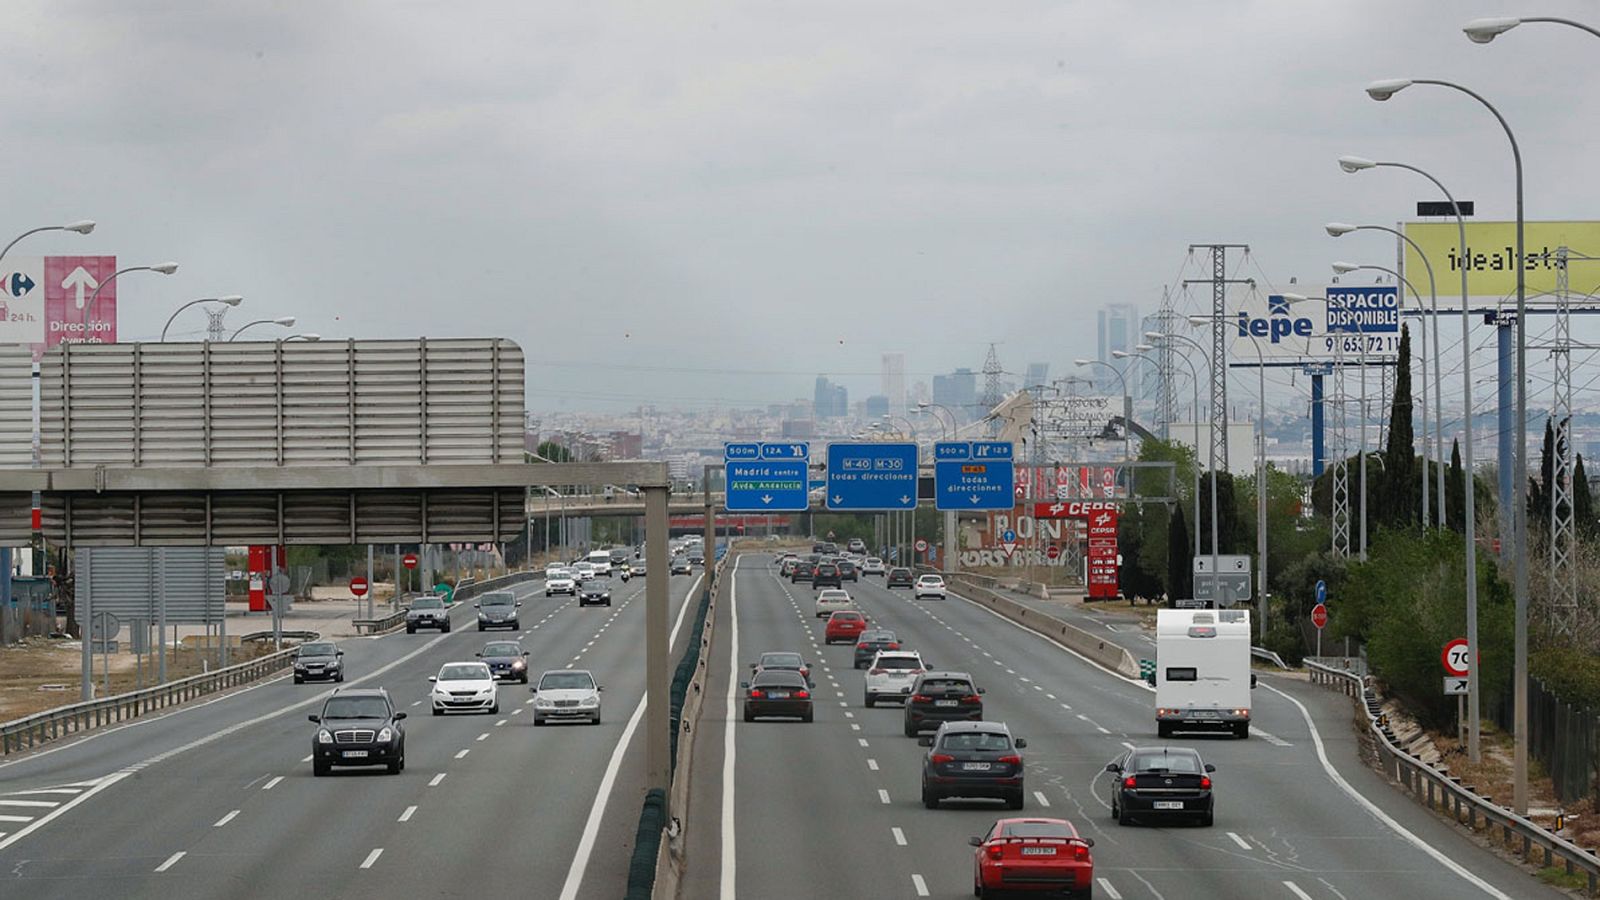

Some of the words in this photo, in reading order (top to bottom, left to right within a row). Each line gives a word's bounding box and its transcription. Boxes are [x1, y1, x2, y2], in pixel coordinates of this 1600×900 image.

[1448, 247, 1567, 271] idealsta
[1328, 293, 1397, 308] ESPACIO
[10, 314, 24, 322] 24
[1328, 310, 1397, 326] DISPONIBLE
[1238, 312, 1313, 344] iepe
[60, 336, 102, 344] Avenda
[1369, 337, 1383, 352] 72
[729, 447, 755, 455] 500m
[845, 460, 870, 469] M-40
[875, 460, 901, 469] M-30
[735, 468, 769, 476] Madrid
[861, 472, 914, 480] direcciones
